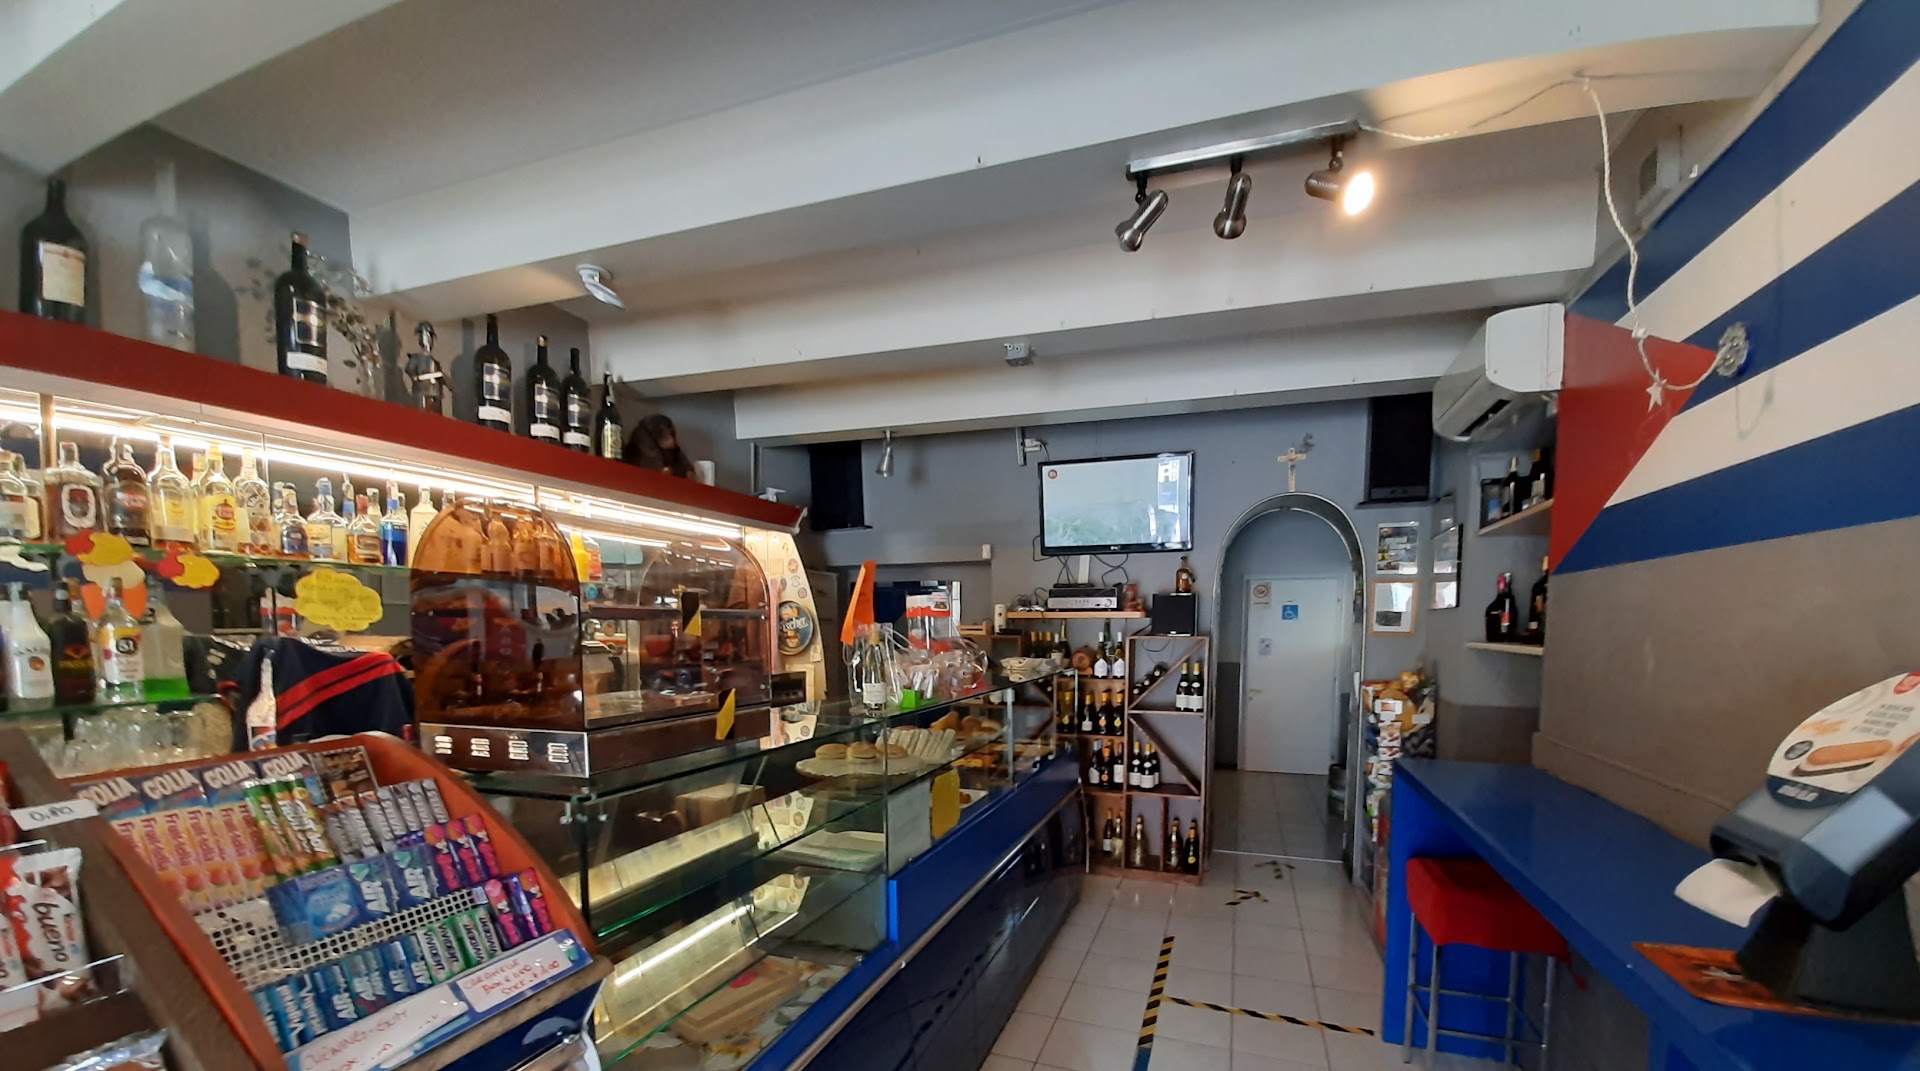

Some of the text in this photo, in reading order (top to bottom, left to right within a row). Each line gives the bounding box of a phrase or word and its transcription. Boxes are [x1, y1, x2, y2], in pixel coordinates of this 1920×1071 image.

[360, 881, 391, 913] AIR
[404, 867, 431, 899] AIR
[32, 901, 70, 963] bueno
[332, 992, 359, 1019] AIR
